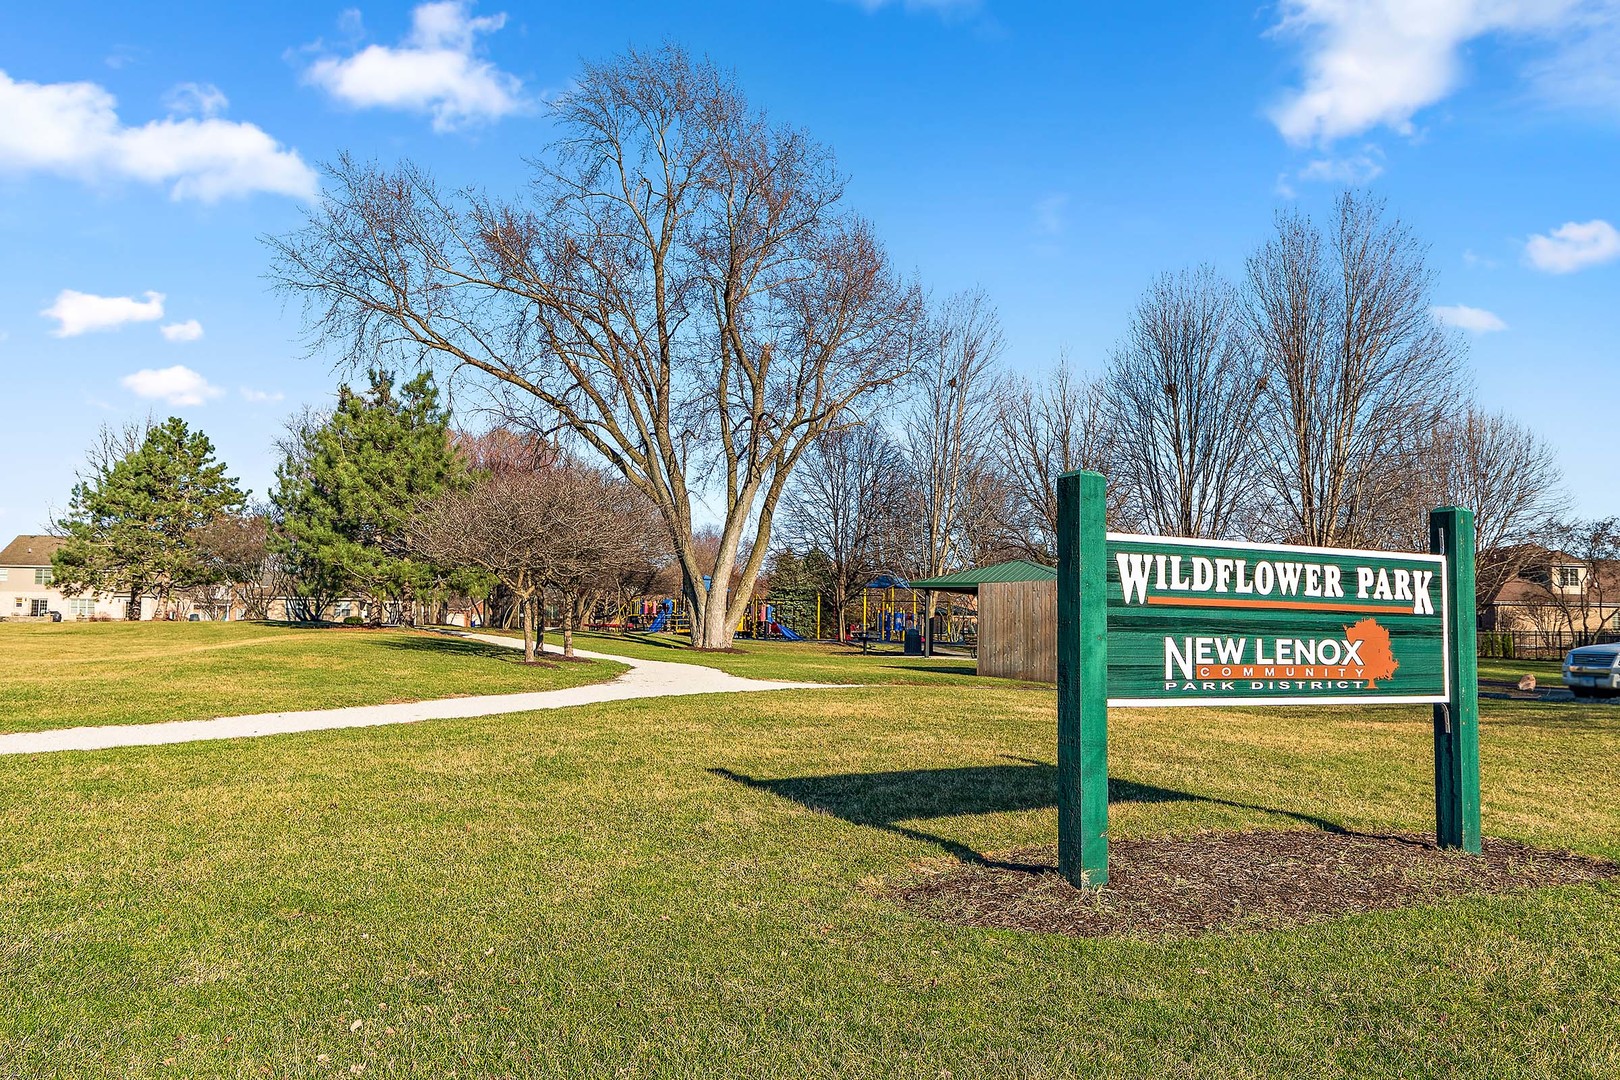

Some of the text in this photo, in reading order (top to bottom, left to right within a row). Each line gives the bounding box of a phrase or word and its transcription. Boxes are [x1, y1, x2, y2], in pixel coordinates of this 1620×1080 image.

[1115, 552, 1435, 615] WILDFLOWER PARK
[1164, 636, 1364, 680] NEW LENOX
[1165, 680, 1364, 690] PARK DISTRICT
[1200, 667, 1364, 678] COMMUNITY
